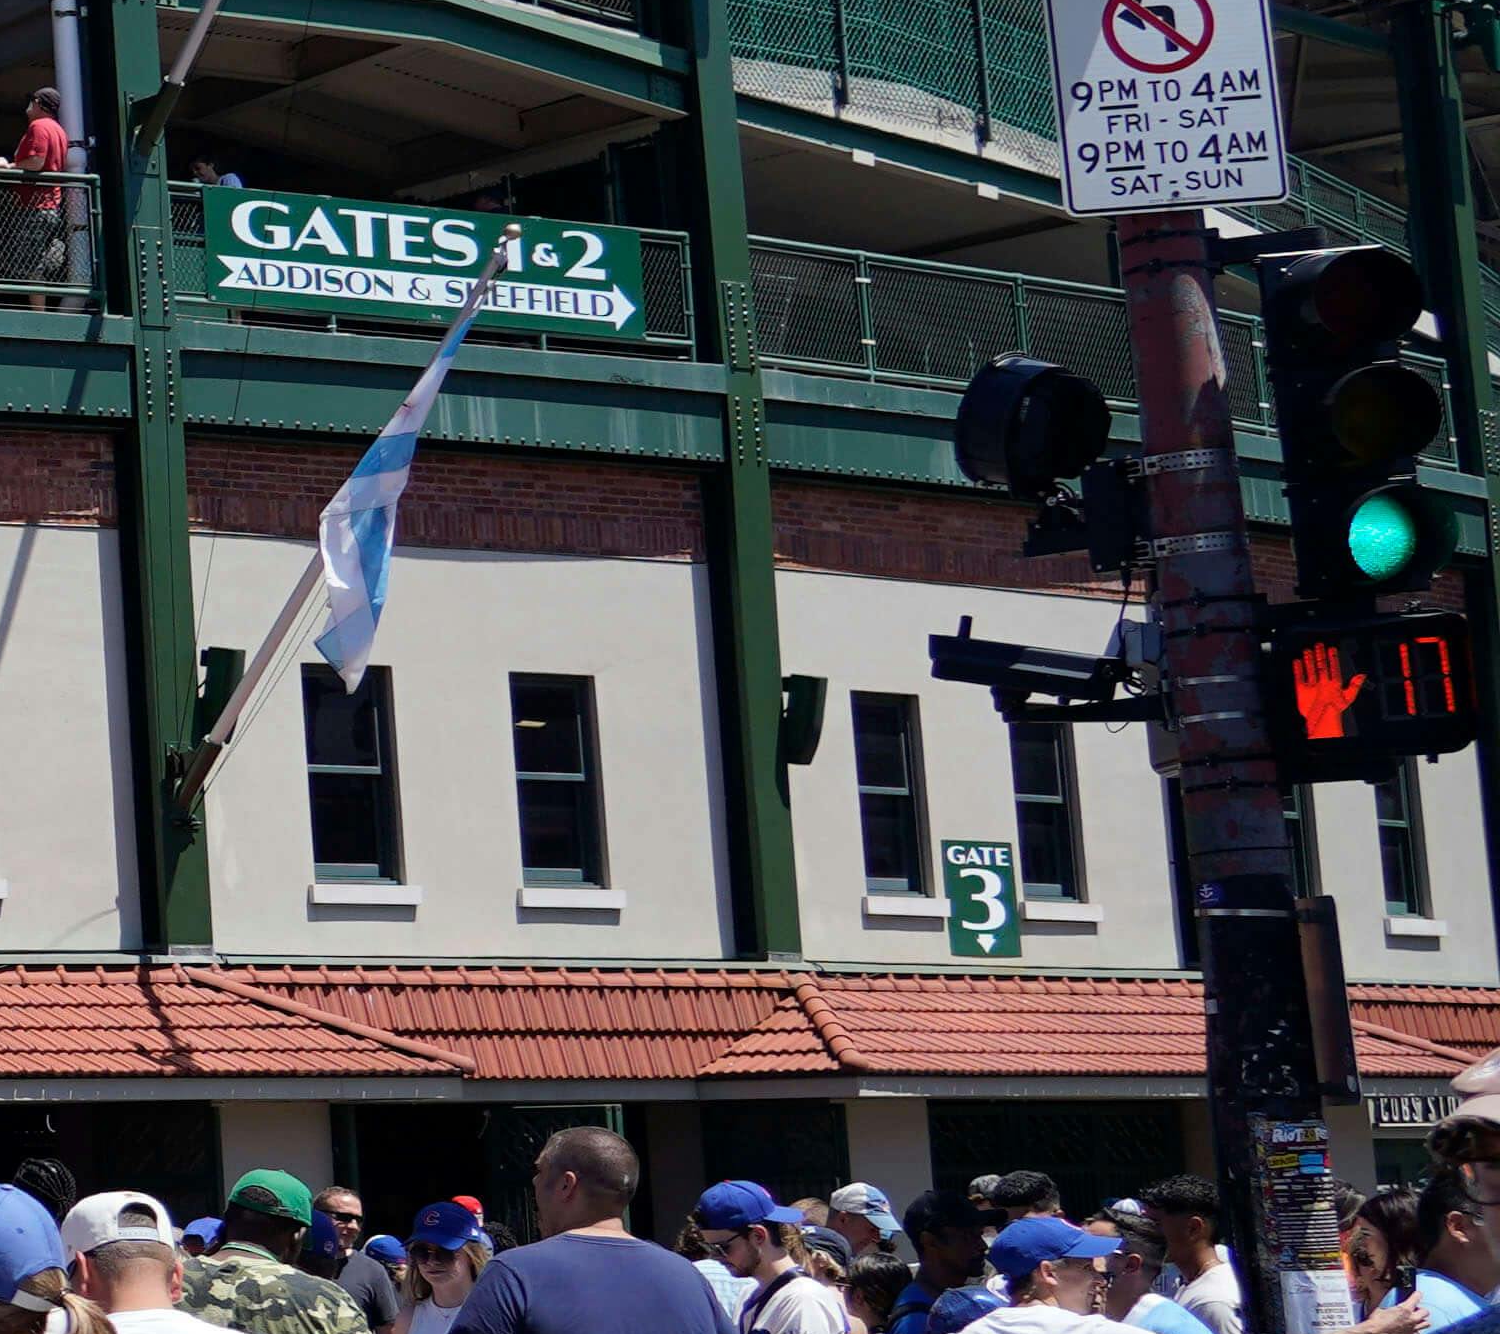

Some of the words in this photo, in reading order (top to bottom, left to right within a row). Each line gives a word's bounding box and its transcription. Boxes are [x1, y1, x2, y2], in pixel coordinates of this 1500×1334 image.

[1071, 78, 1138, 112] 9PM
[1148, 79, 1181, 103] TO
[1191, 69, 1261, 103] 4AM
[1107, 112, 1150, 134] FRI
[1179, 107, 1229, 129] SAT
[1077, 139, 1145, 173] 9PM
[1155, 141, 1188, 164] TO
[1198, 130, 1268, 164] 4AM
[230, 200, 479, 267] GATES
[532, 243, 558, 268] &
[562, 229, 607, 281] 2
[235, 262, 395, 297] ADDISON
[407, 277, 431, 302] &
[1398, 636, 1456, 715] 17
[946, 845, 1011, 866] GATE
[959, 868, 1007, 931] 3
